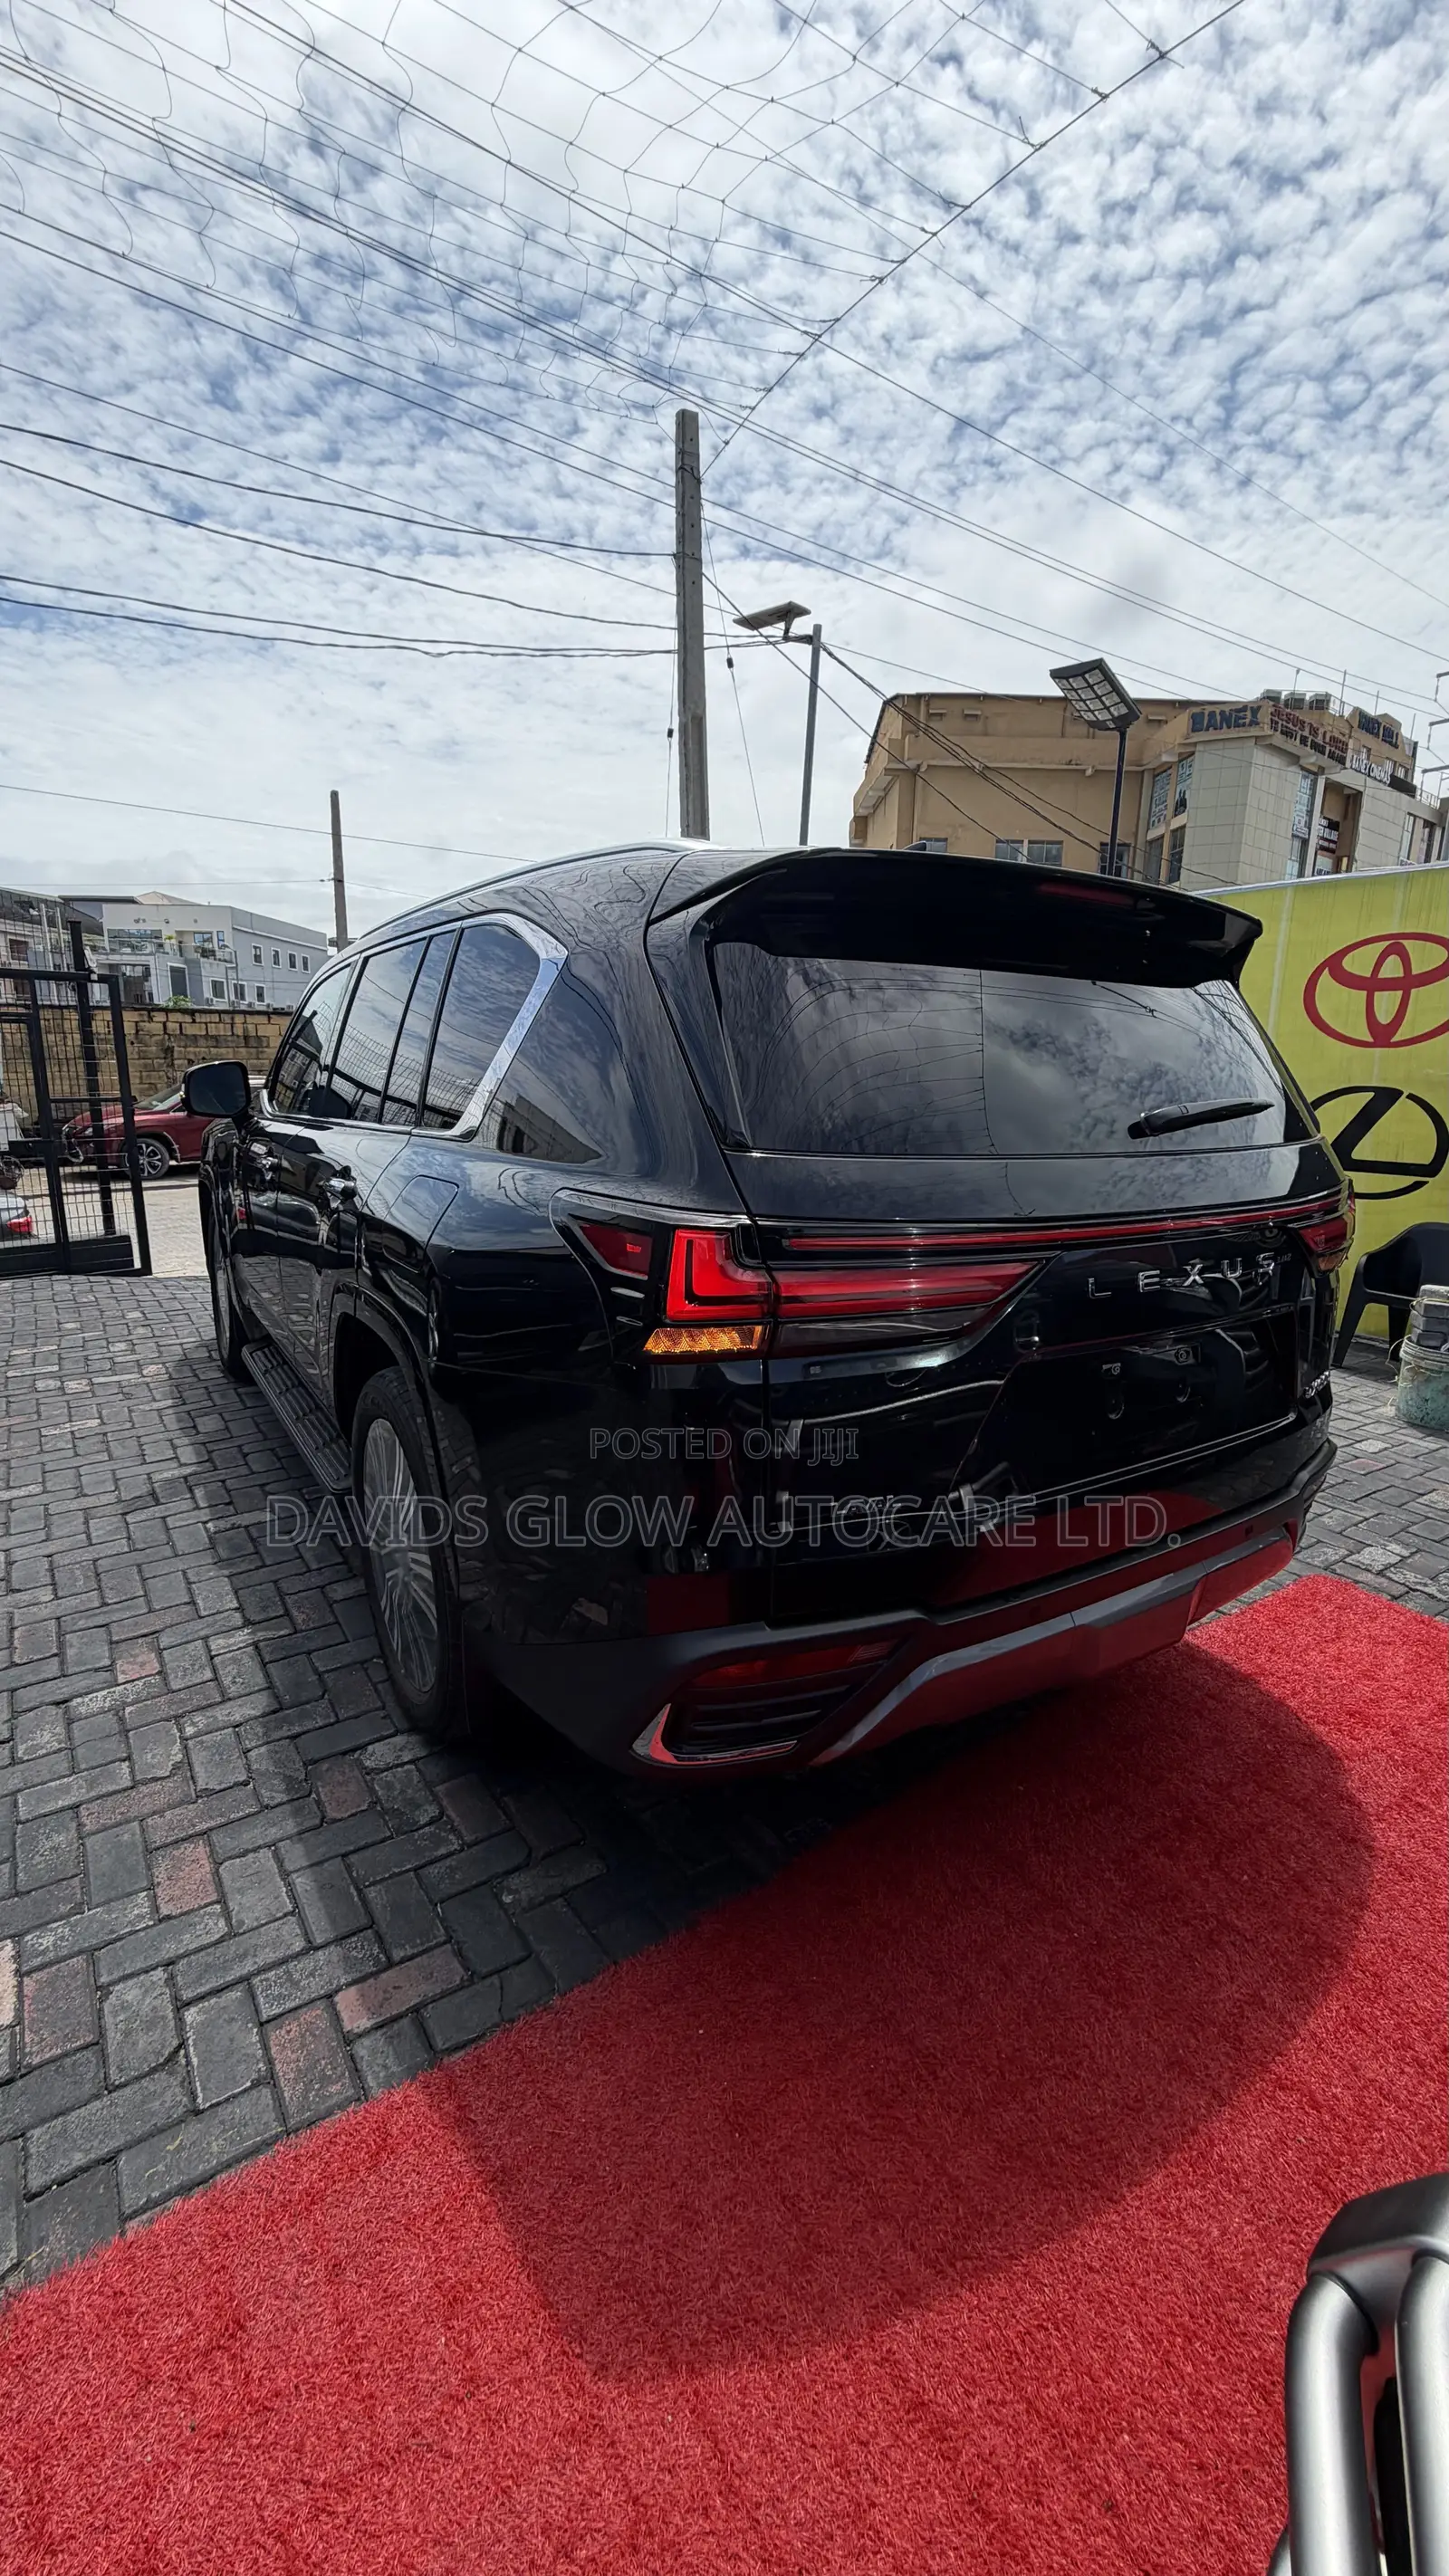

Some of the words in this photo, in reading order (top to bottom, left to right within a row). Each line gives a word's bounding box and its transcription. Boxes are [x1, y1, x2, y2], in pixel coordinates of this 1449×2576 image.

[1191, 704, 1262, 733] BANEX
[1270, 704, 1307, 732] JESUS
[1308, 722, 1319, 738] IS
[1087, 1251, 1276, 1299] LEXUS
